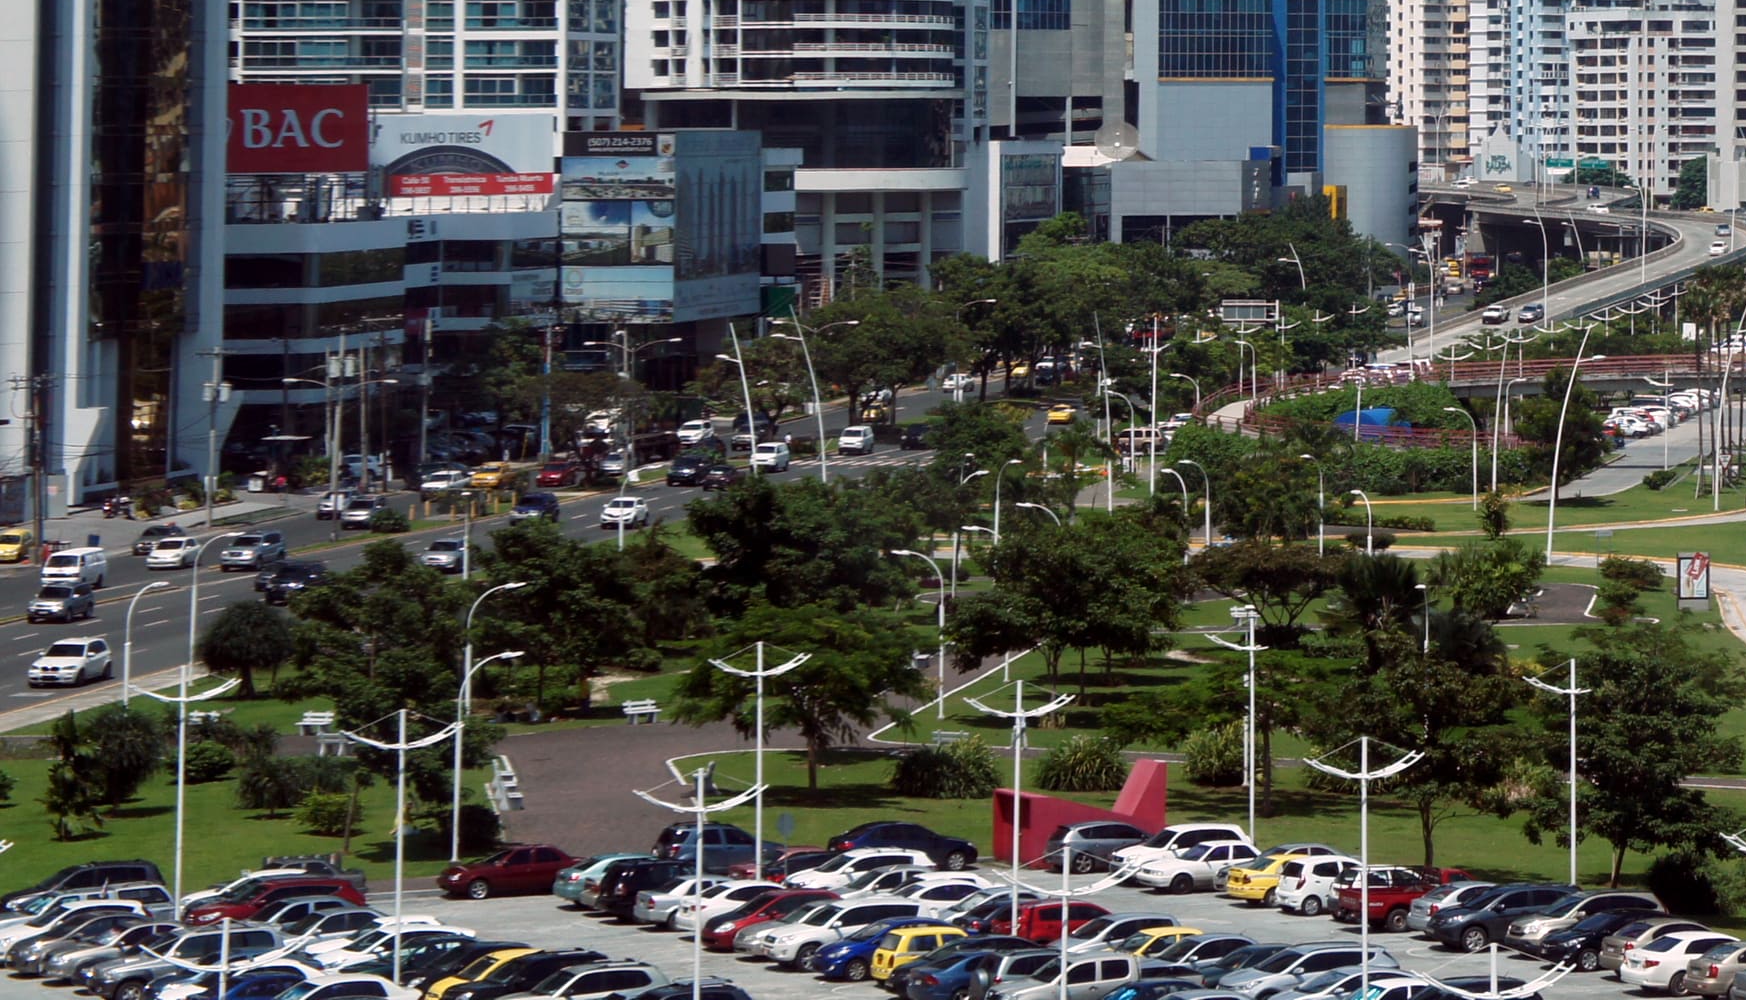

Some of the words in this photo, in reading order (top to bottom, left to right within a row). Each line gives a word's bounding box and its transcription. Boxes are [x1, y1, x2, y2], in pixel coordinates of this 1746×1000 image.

[240, 108, 344, 148] BAC
[400, 131, 446, 144] KUMHO
[448, 131, 482, 144] TIRES
[587, 137, 610, 147] (507)
[612, 137, 653, 146] 214-2376
